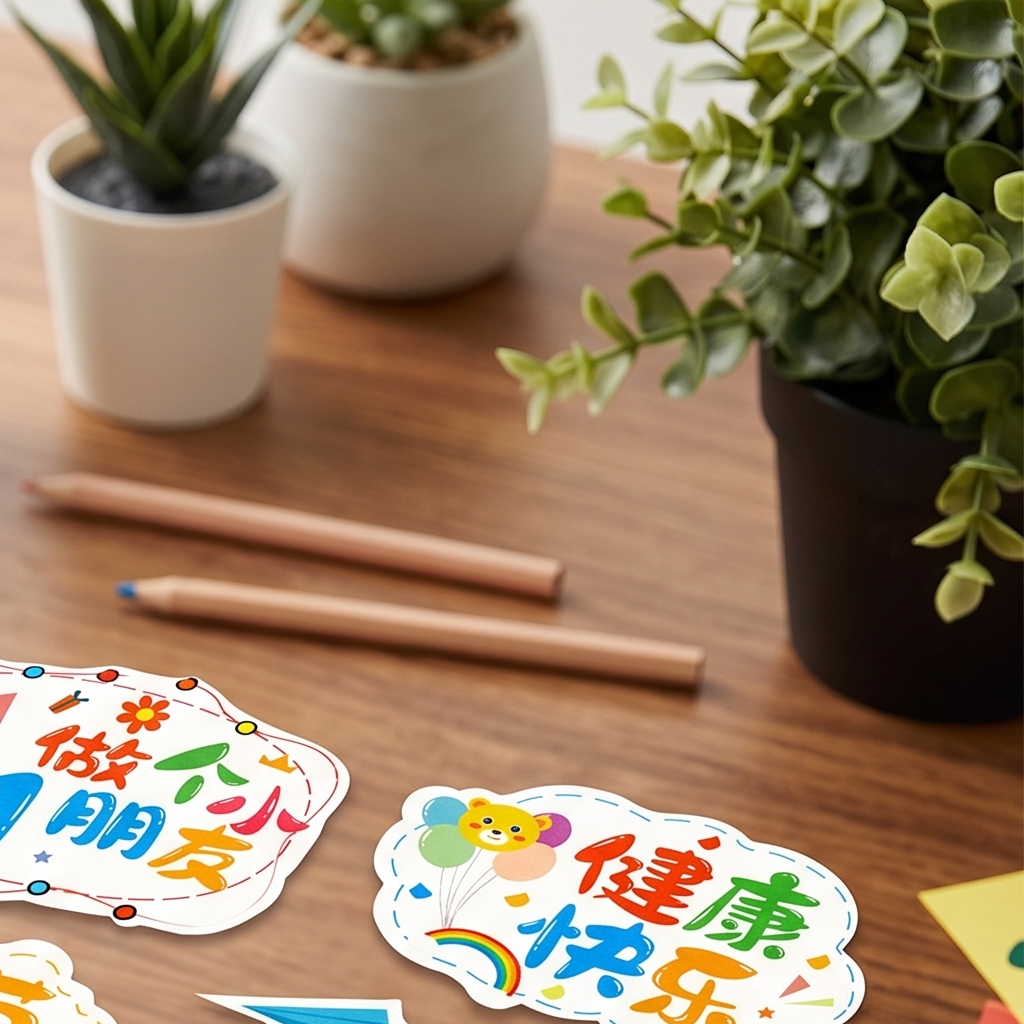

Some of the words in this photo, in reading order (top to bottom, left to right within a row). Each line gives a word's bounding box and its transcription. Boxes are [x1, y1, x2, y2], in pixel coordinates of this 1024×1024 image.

[35, 725, 310, 836] 做个小
[45, 789, 253, 892] 朋友
[574, 833, 821, 959] 健康
